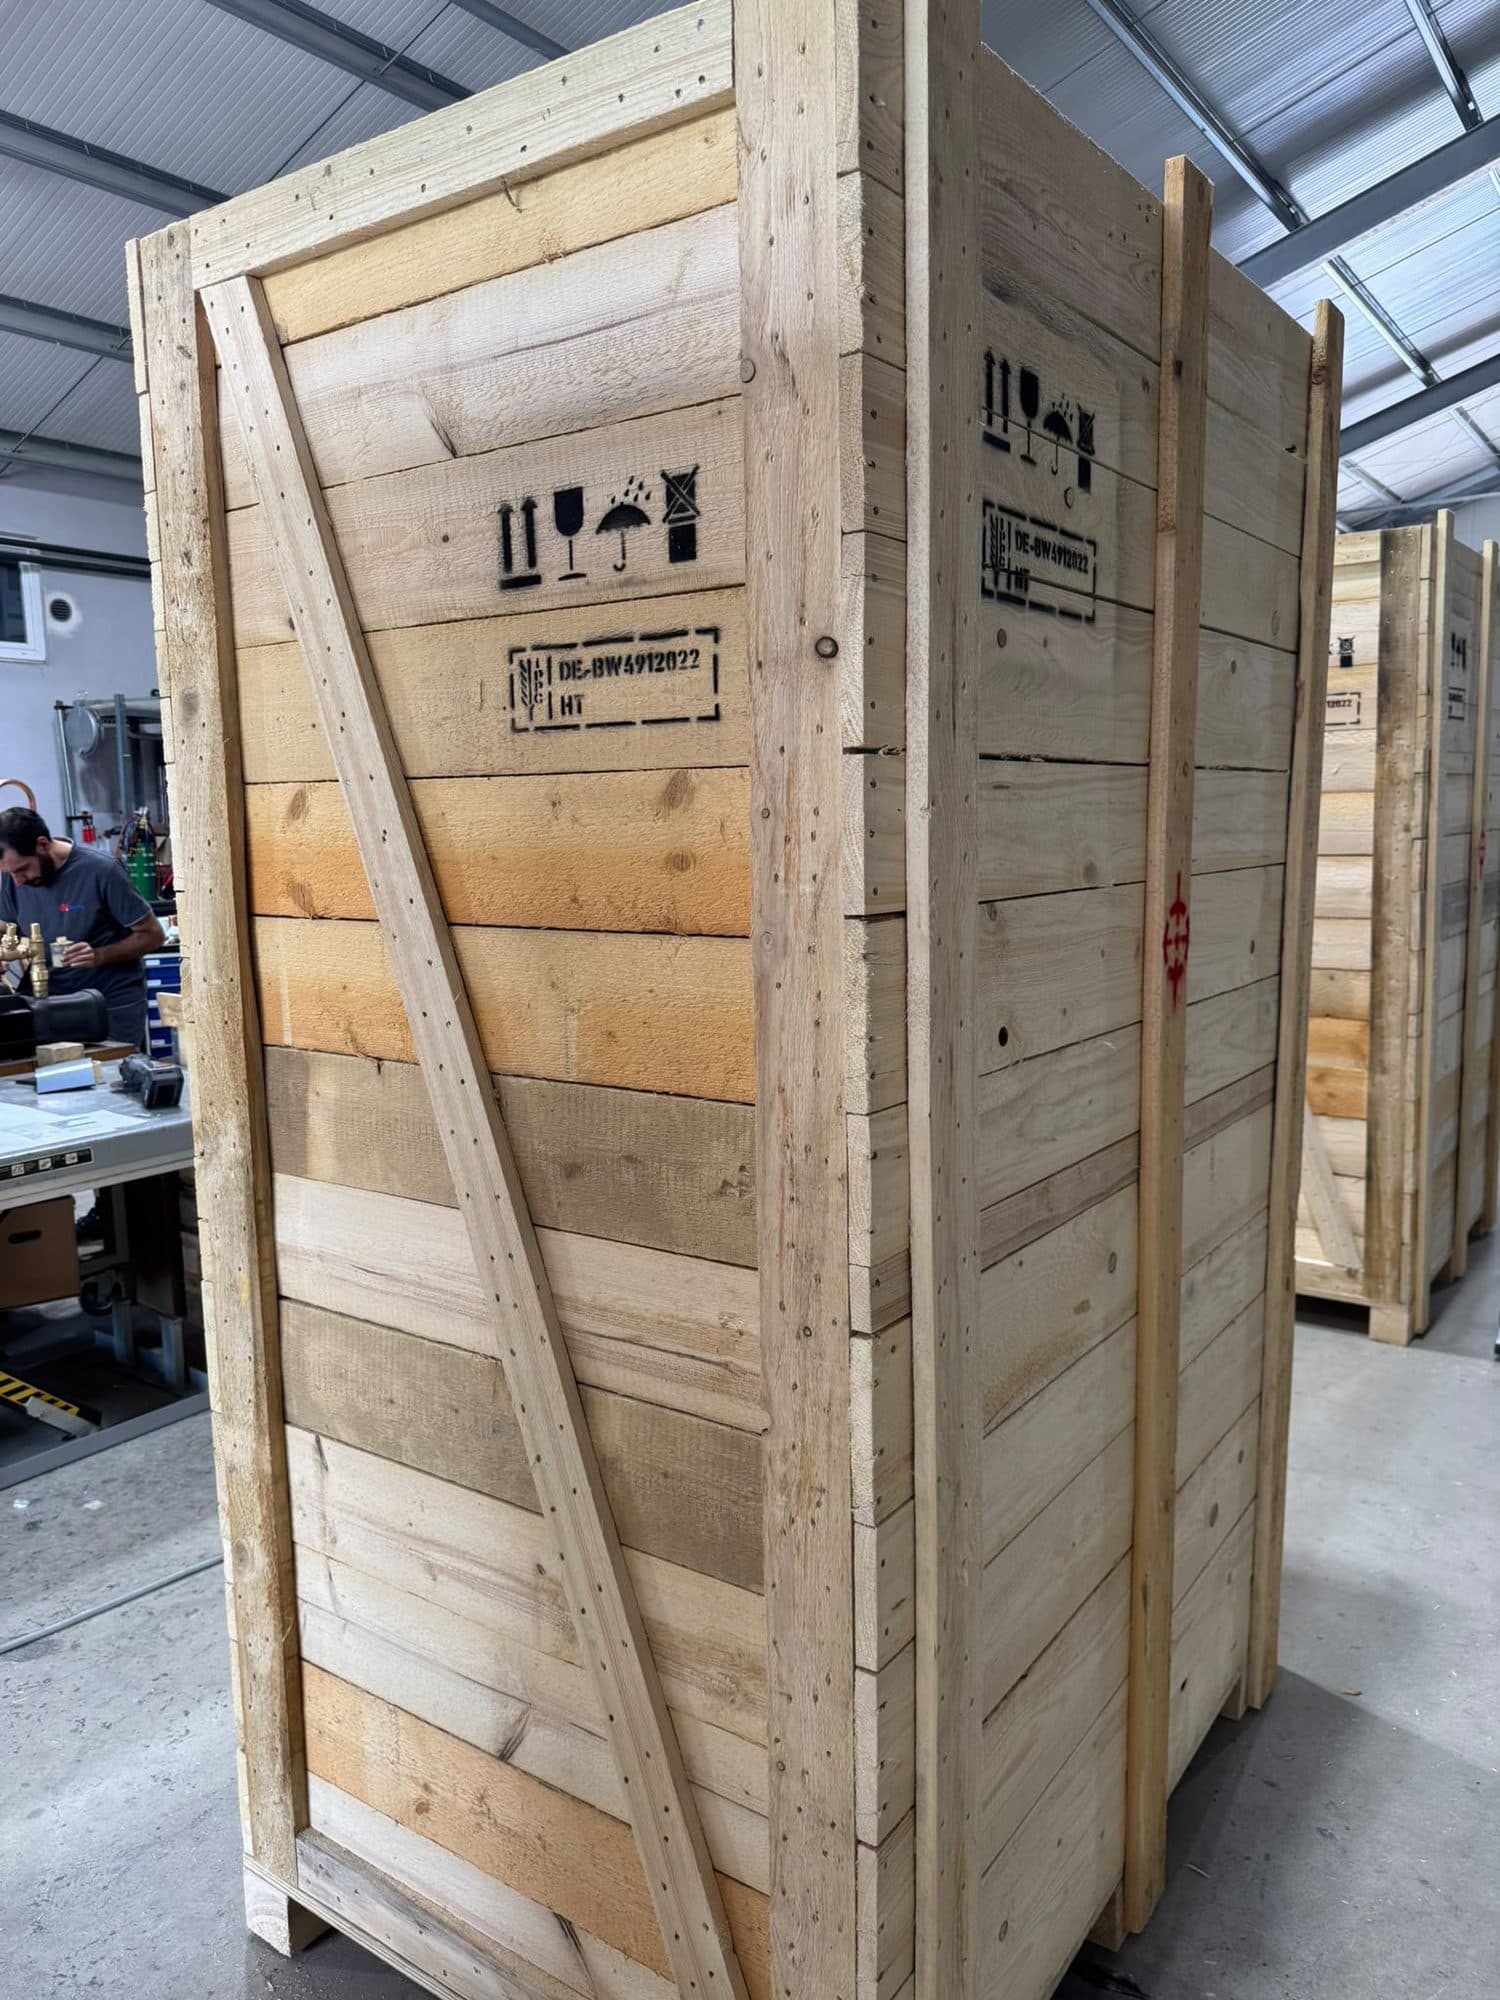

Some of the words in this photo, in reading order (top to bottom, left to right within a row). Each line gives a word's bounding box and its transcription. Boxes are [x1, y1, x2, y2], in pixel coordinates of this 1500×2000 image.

[1015, 529, 1089, 574] DE-BW4912022
[533, 657, 544, 704] IPPC
[559, 648, 700, 681] DE-BW4912022
[560, 694, 585, 716] HT
